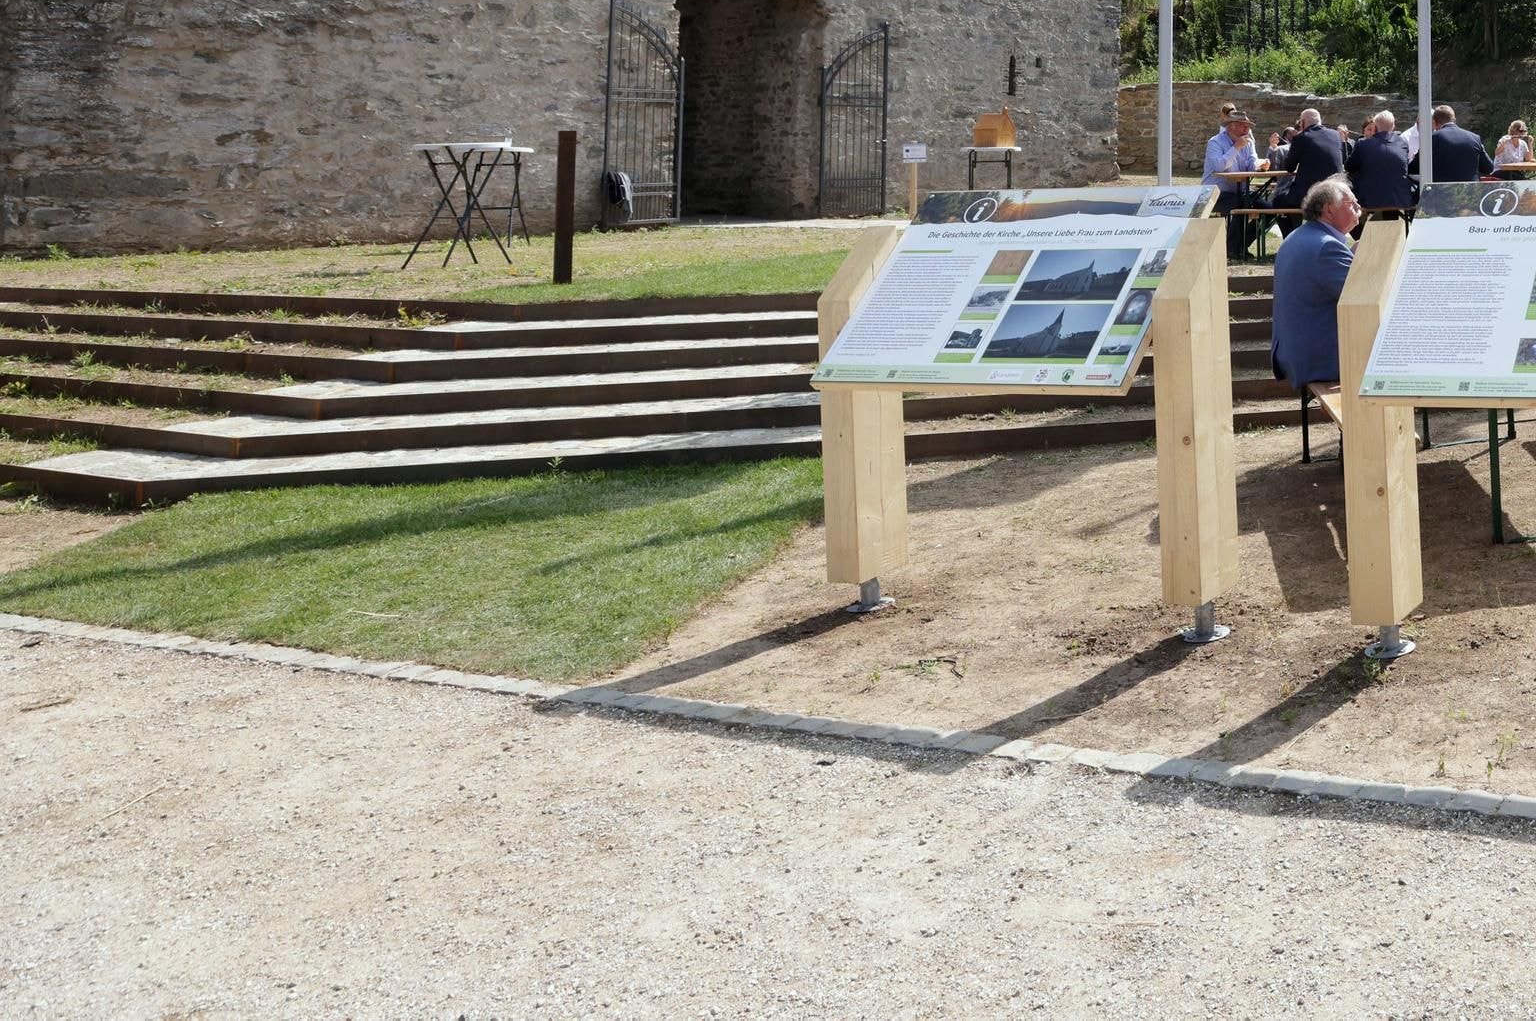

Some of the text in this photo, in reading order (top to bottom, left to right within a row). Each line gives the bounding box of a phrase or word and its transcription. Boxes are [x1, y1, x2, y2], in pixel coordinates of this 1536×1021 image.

[1149, 198, 1186, 207] Taunus
[928, 230, 940, 239] Die
[942, 229, 981, 239] Geschichte
[983, 229, 996, 238] der
[998, 229, 1020, 238] Kirche
[1054, 228, 1076, 237] Liebe
[1077, 228, 1095, 236] Frau
[1468, 225, 1490, 234] Bau-
[1493, 225, 1511, 233] und
